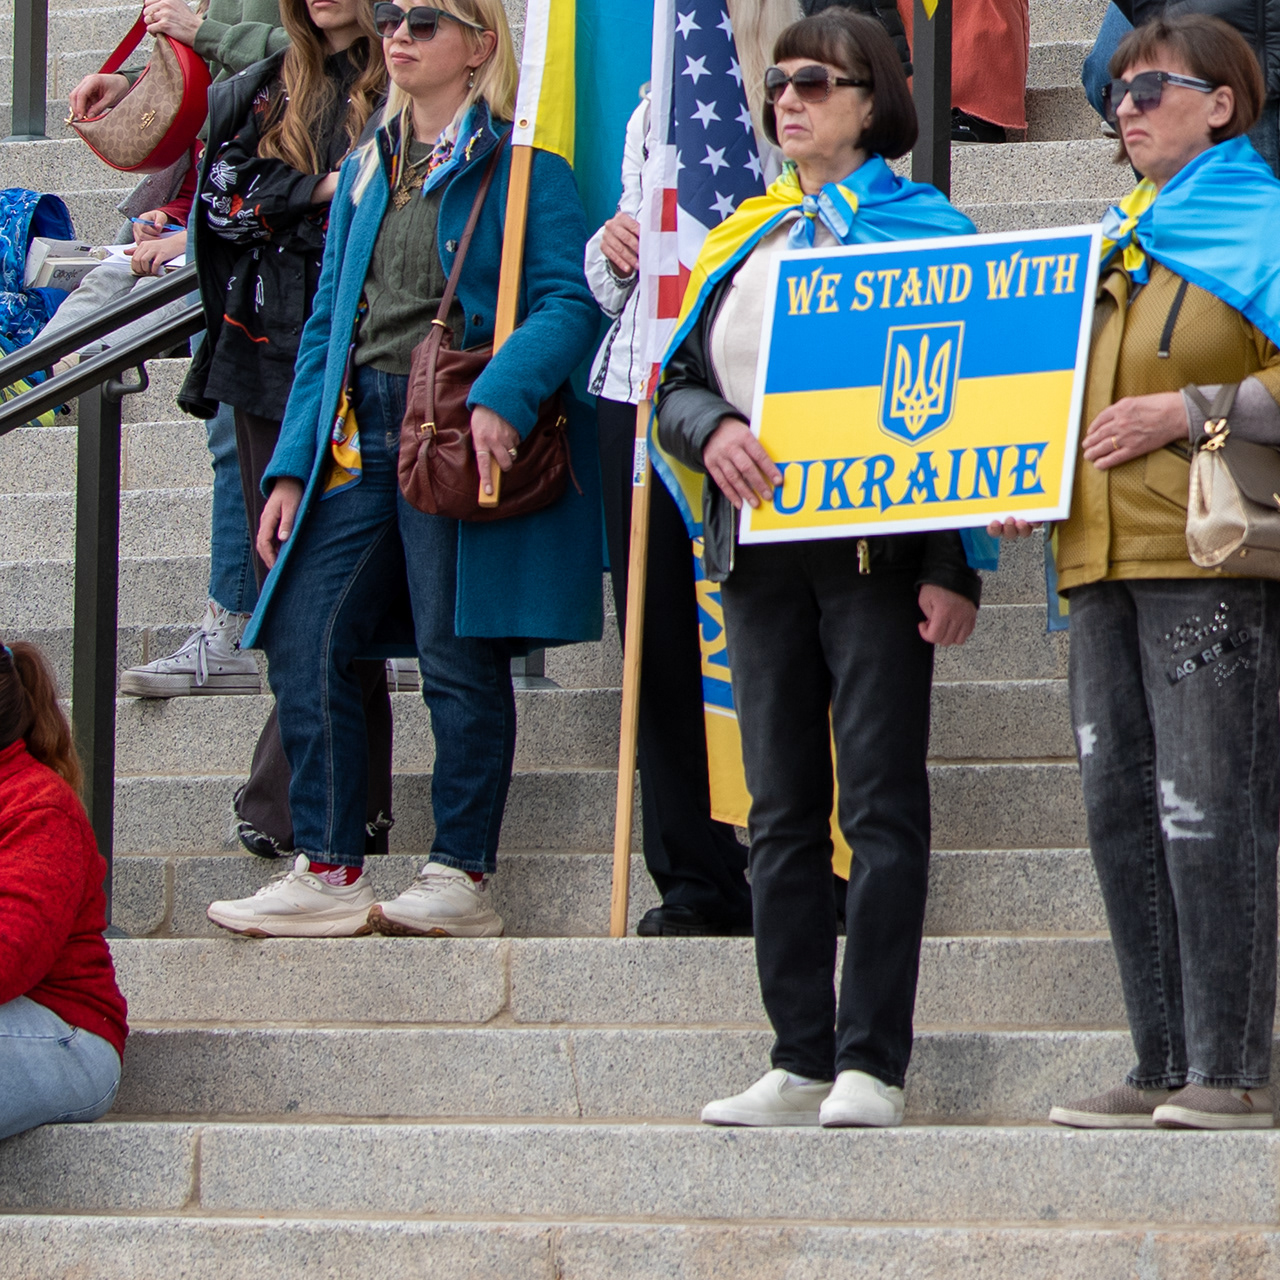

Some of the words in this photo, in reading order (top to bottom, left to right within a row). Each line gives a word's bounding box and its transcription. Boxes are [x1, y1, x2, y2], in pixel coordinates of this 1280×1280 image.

[787, 266, 842, 315] WE
[850, 263, 972, 311] STAND
[986, 249, 1079, 300] WITH
[773, 441, 1050, 516] UKRAINE
